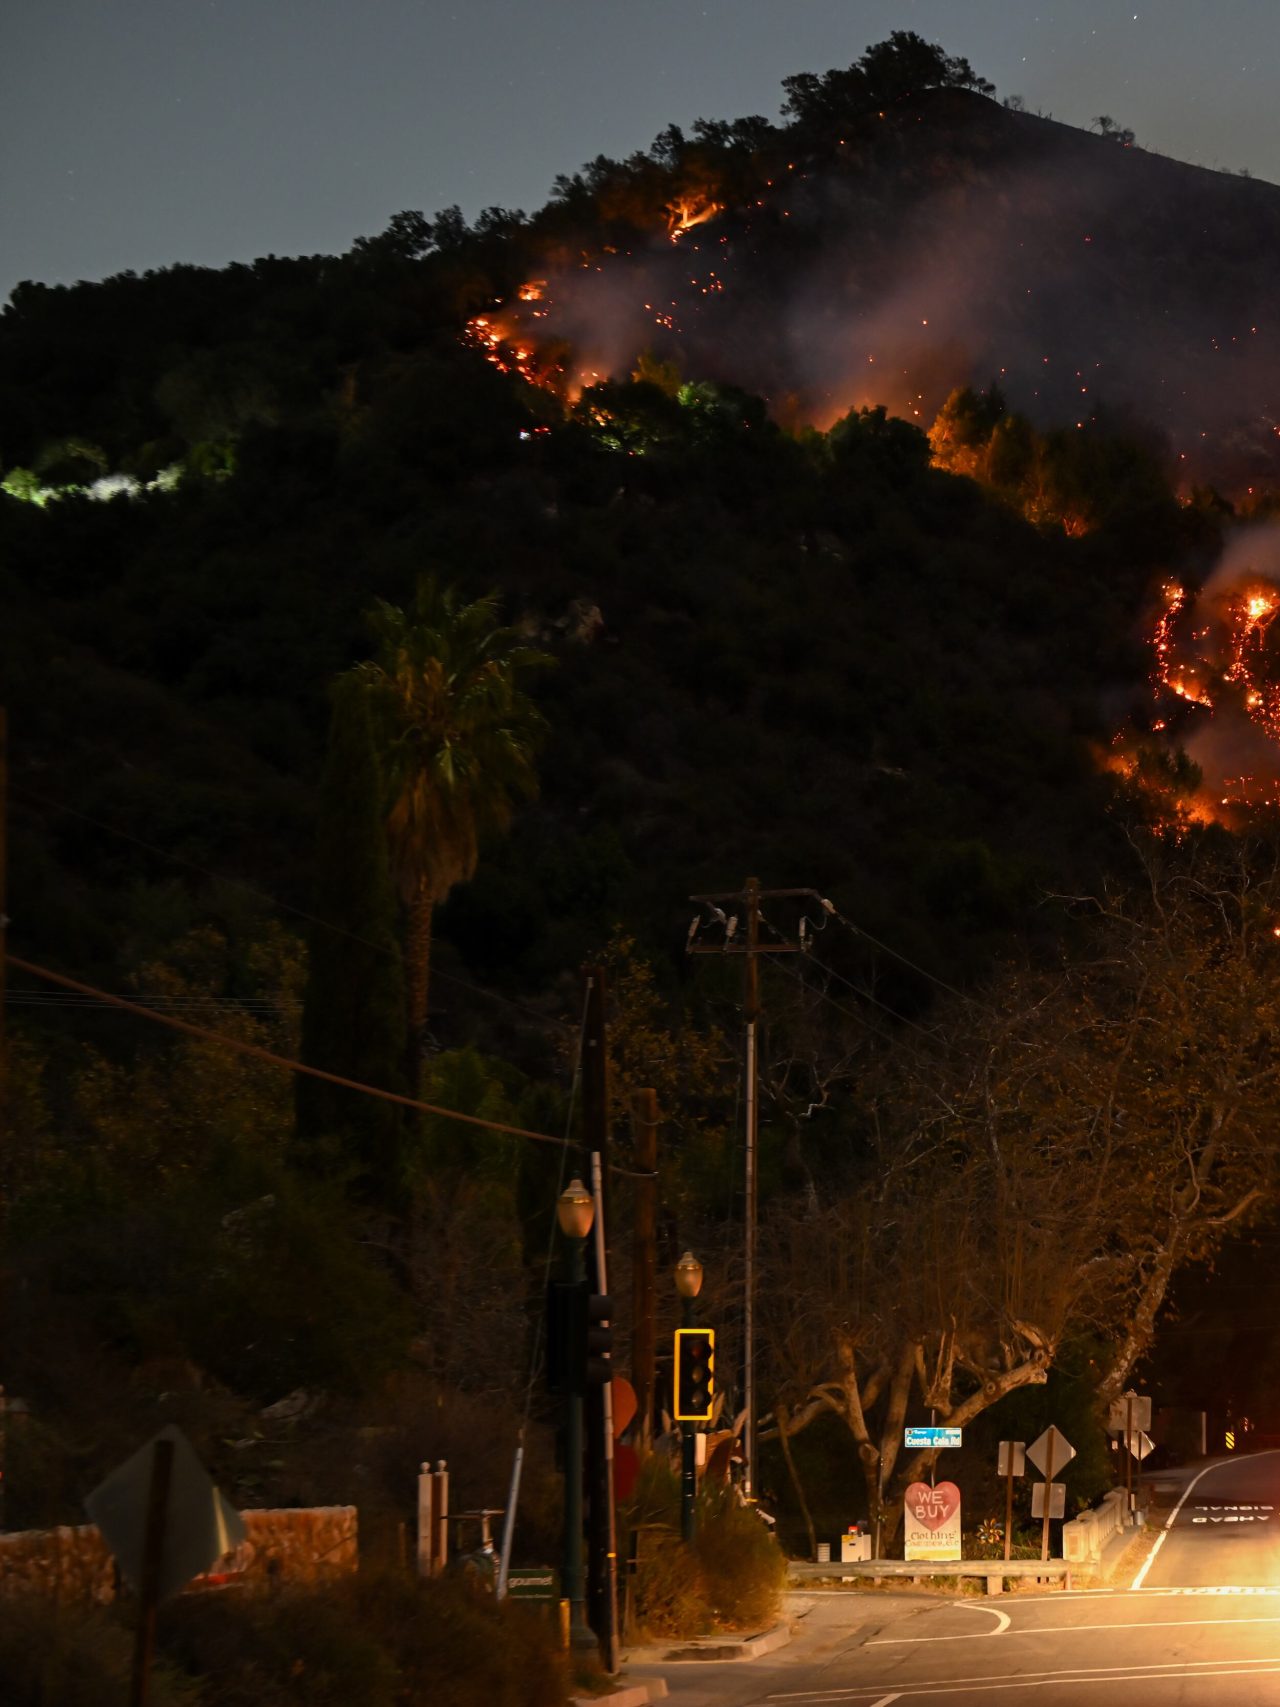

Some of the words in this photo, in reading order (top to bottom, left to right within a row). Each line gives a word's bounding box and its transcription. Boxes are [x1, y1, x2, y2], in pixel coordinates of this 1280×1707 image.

[918, 1490, 944, 1504] WE
[915, 1504, 949, 1519] BUY
[1192, 1515, 1270, 1523] AHEAD
[509, 1575, 552, 1588] gourmet
